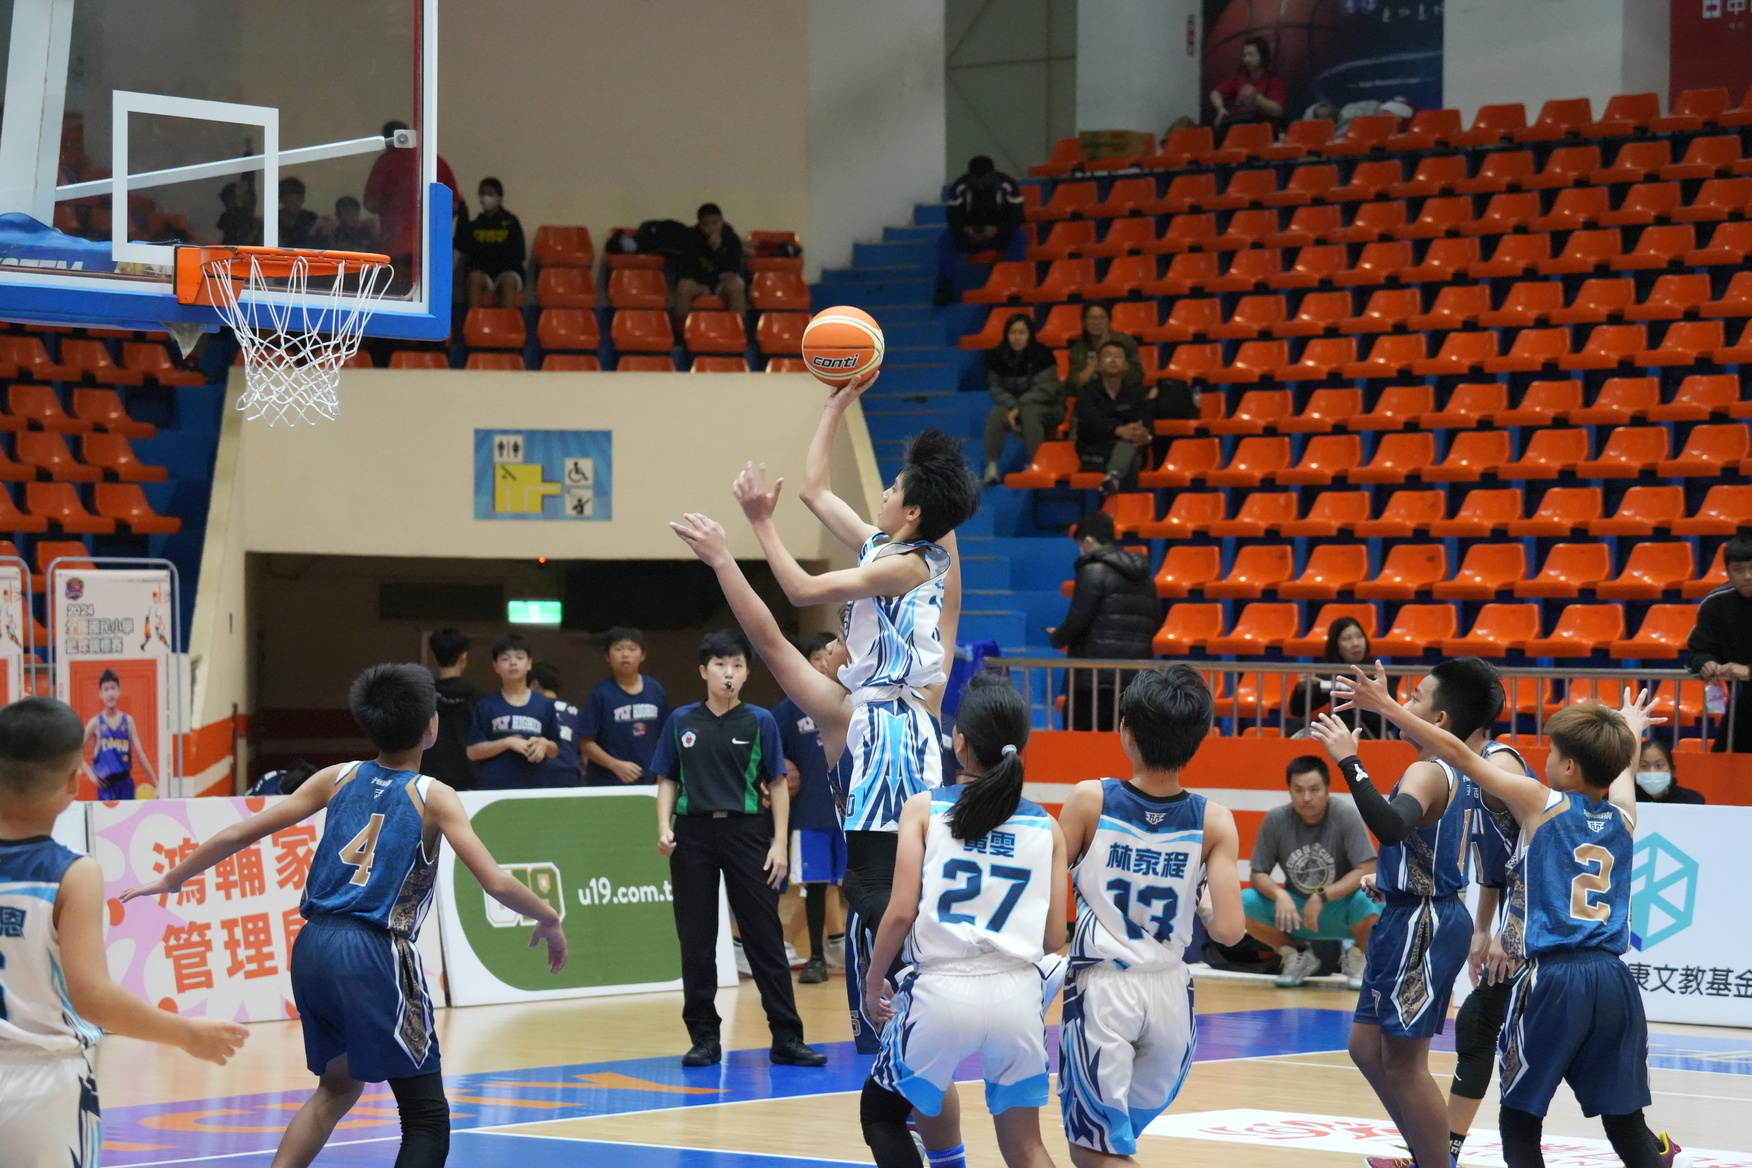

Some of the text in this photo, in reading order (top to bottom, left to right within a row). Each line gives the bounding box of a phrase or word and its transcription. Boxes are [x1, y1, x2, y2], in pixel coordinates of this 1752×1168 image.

[813, 353, 859, 368] conti
[67, 603, 95, 616] 2024
[338, 813, 385, 887] 4
[1106, 842, 1189, 879] 林家程
[1569, 842, 1614, 925] 2
[937, 857, 1032, 933] 27
[1105, 877, 1179, 944] 13
